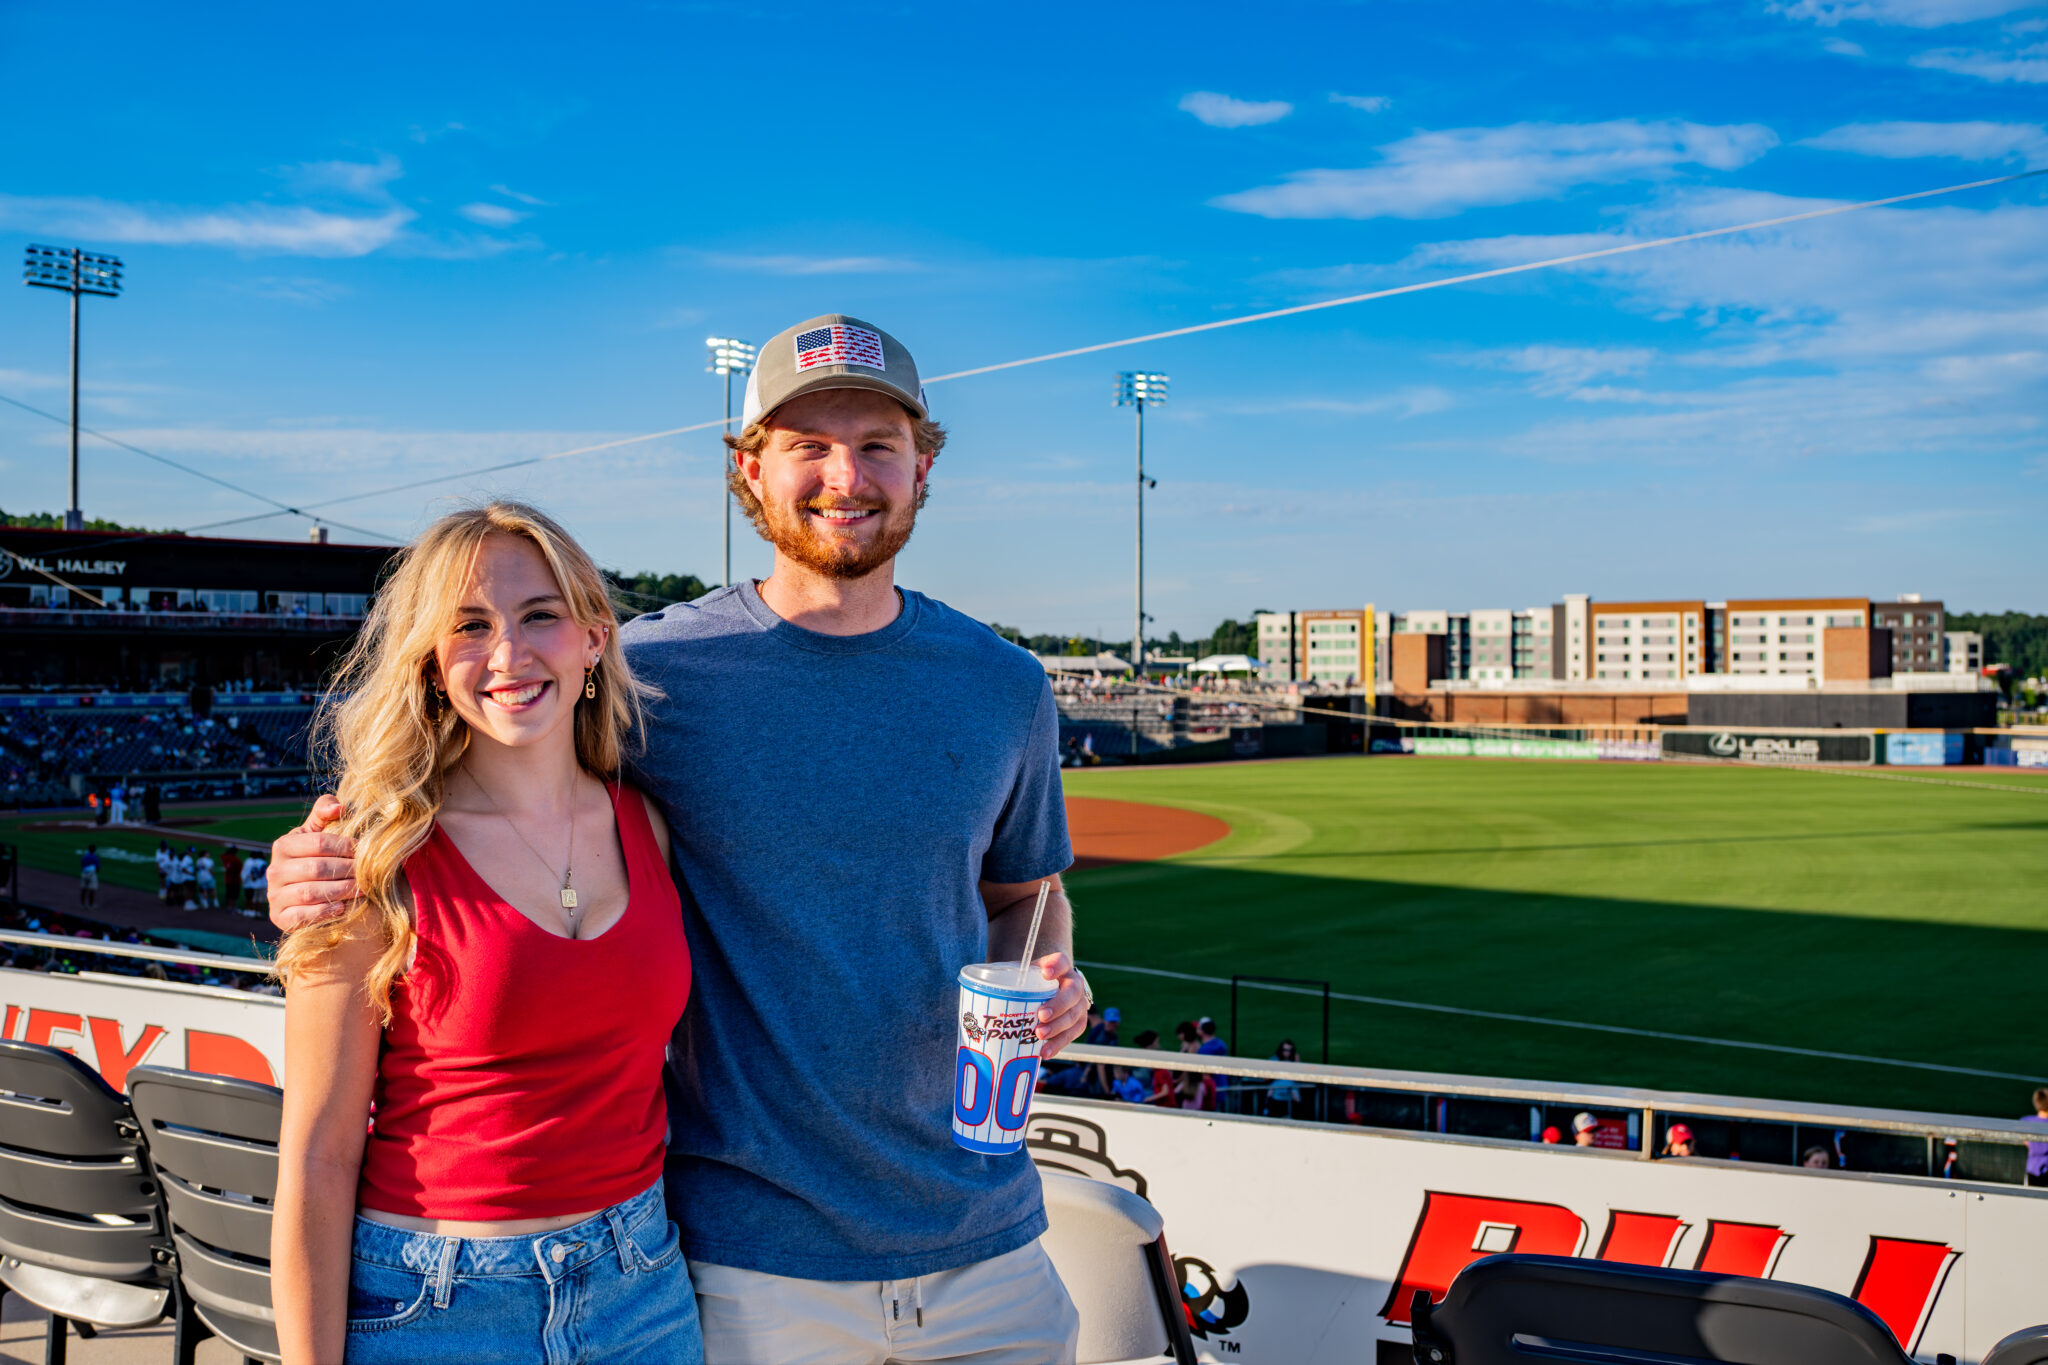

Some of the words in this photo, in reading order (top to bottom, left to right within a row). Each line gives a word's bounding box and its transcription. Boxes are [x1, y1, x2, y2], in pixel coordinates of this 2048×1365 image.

[57, 558, 127, 575] HALSEY
[1739, 737, 1819, 753] LEXUS
[983, 1014, 1035, 1029] TRASH
[955, 1046, 1041, 1131] 00
[1218, 1340, 1241, 1353] TM
